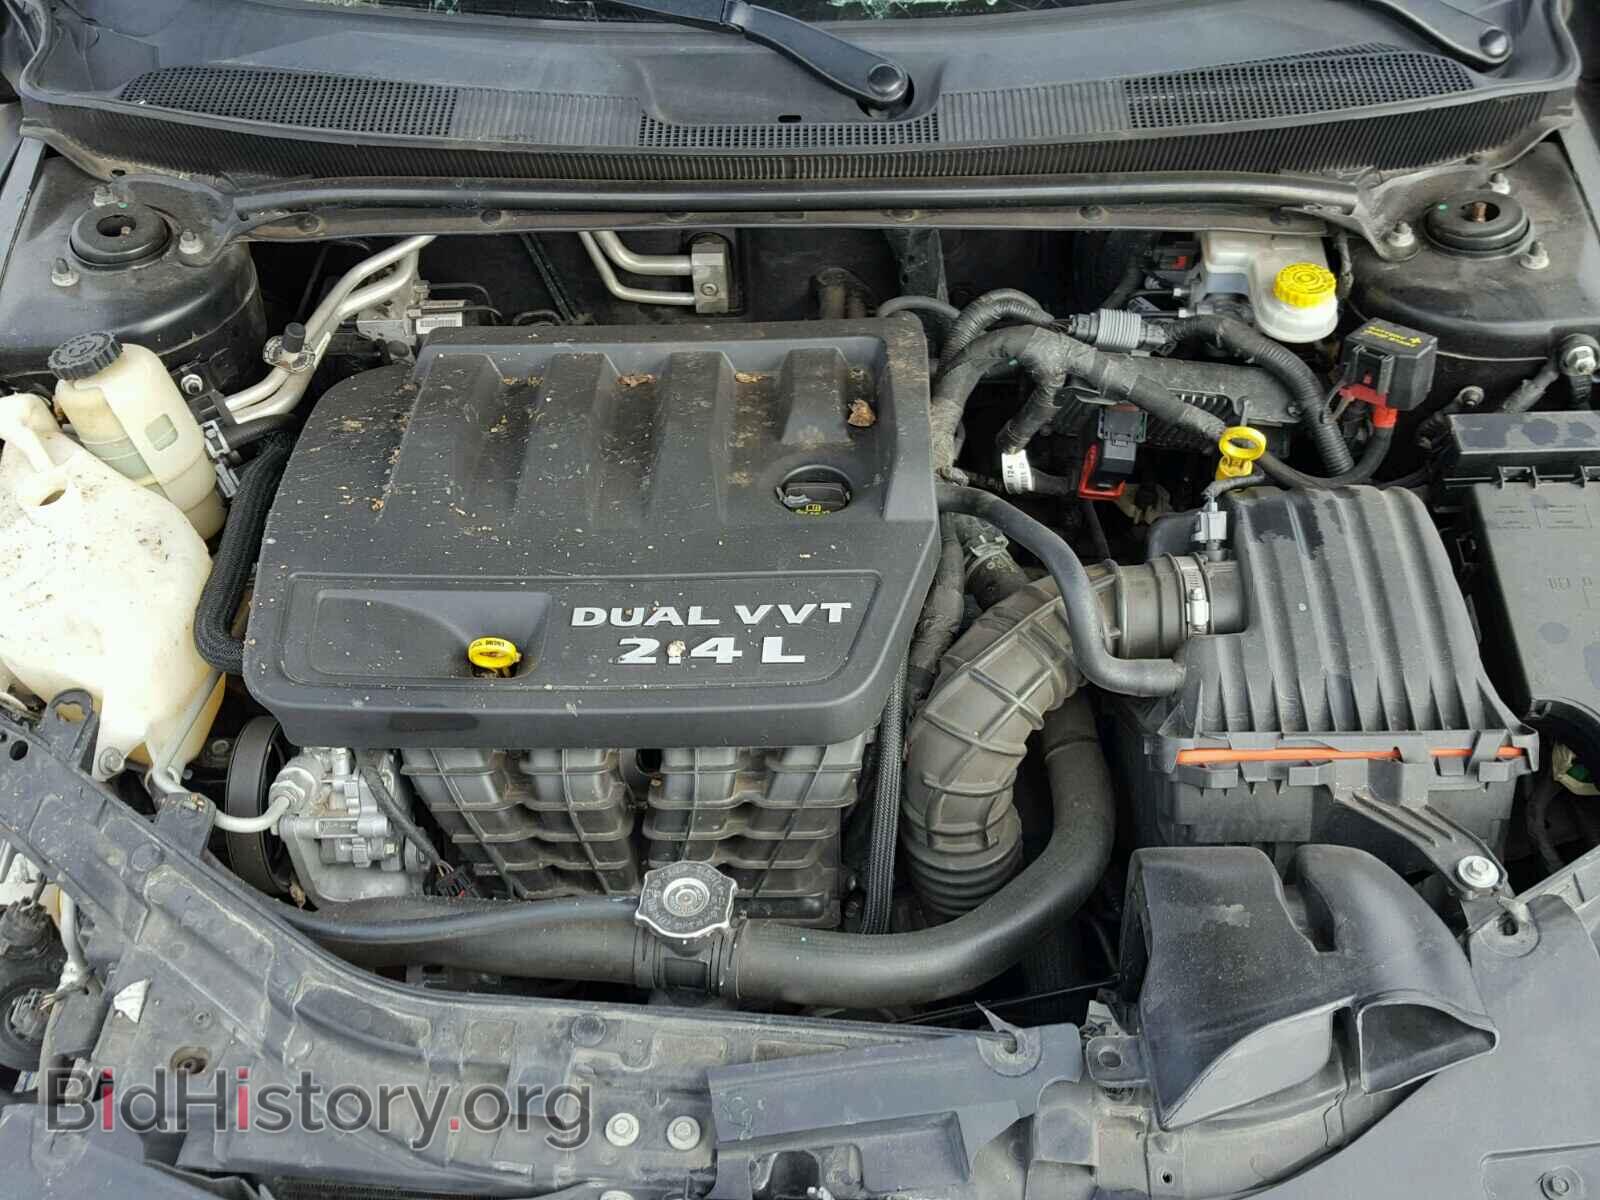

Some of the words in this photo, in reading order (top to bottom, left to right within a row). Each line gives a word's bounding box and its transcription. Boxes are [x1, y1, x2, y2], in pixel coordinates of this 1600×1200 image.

[571, 606, 721, 627] DUAL
[733, 602, 852, 626] VVT
[617, 636, 743, 665] 2.4
[760, 636, 806, 665] L
